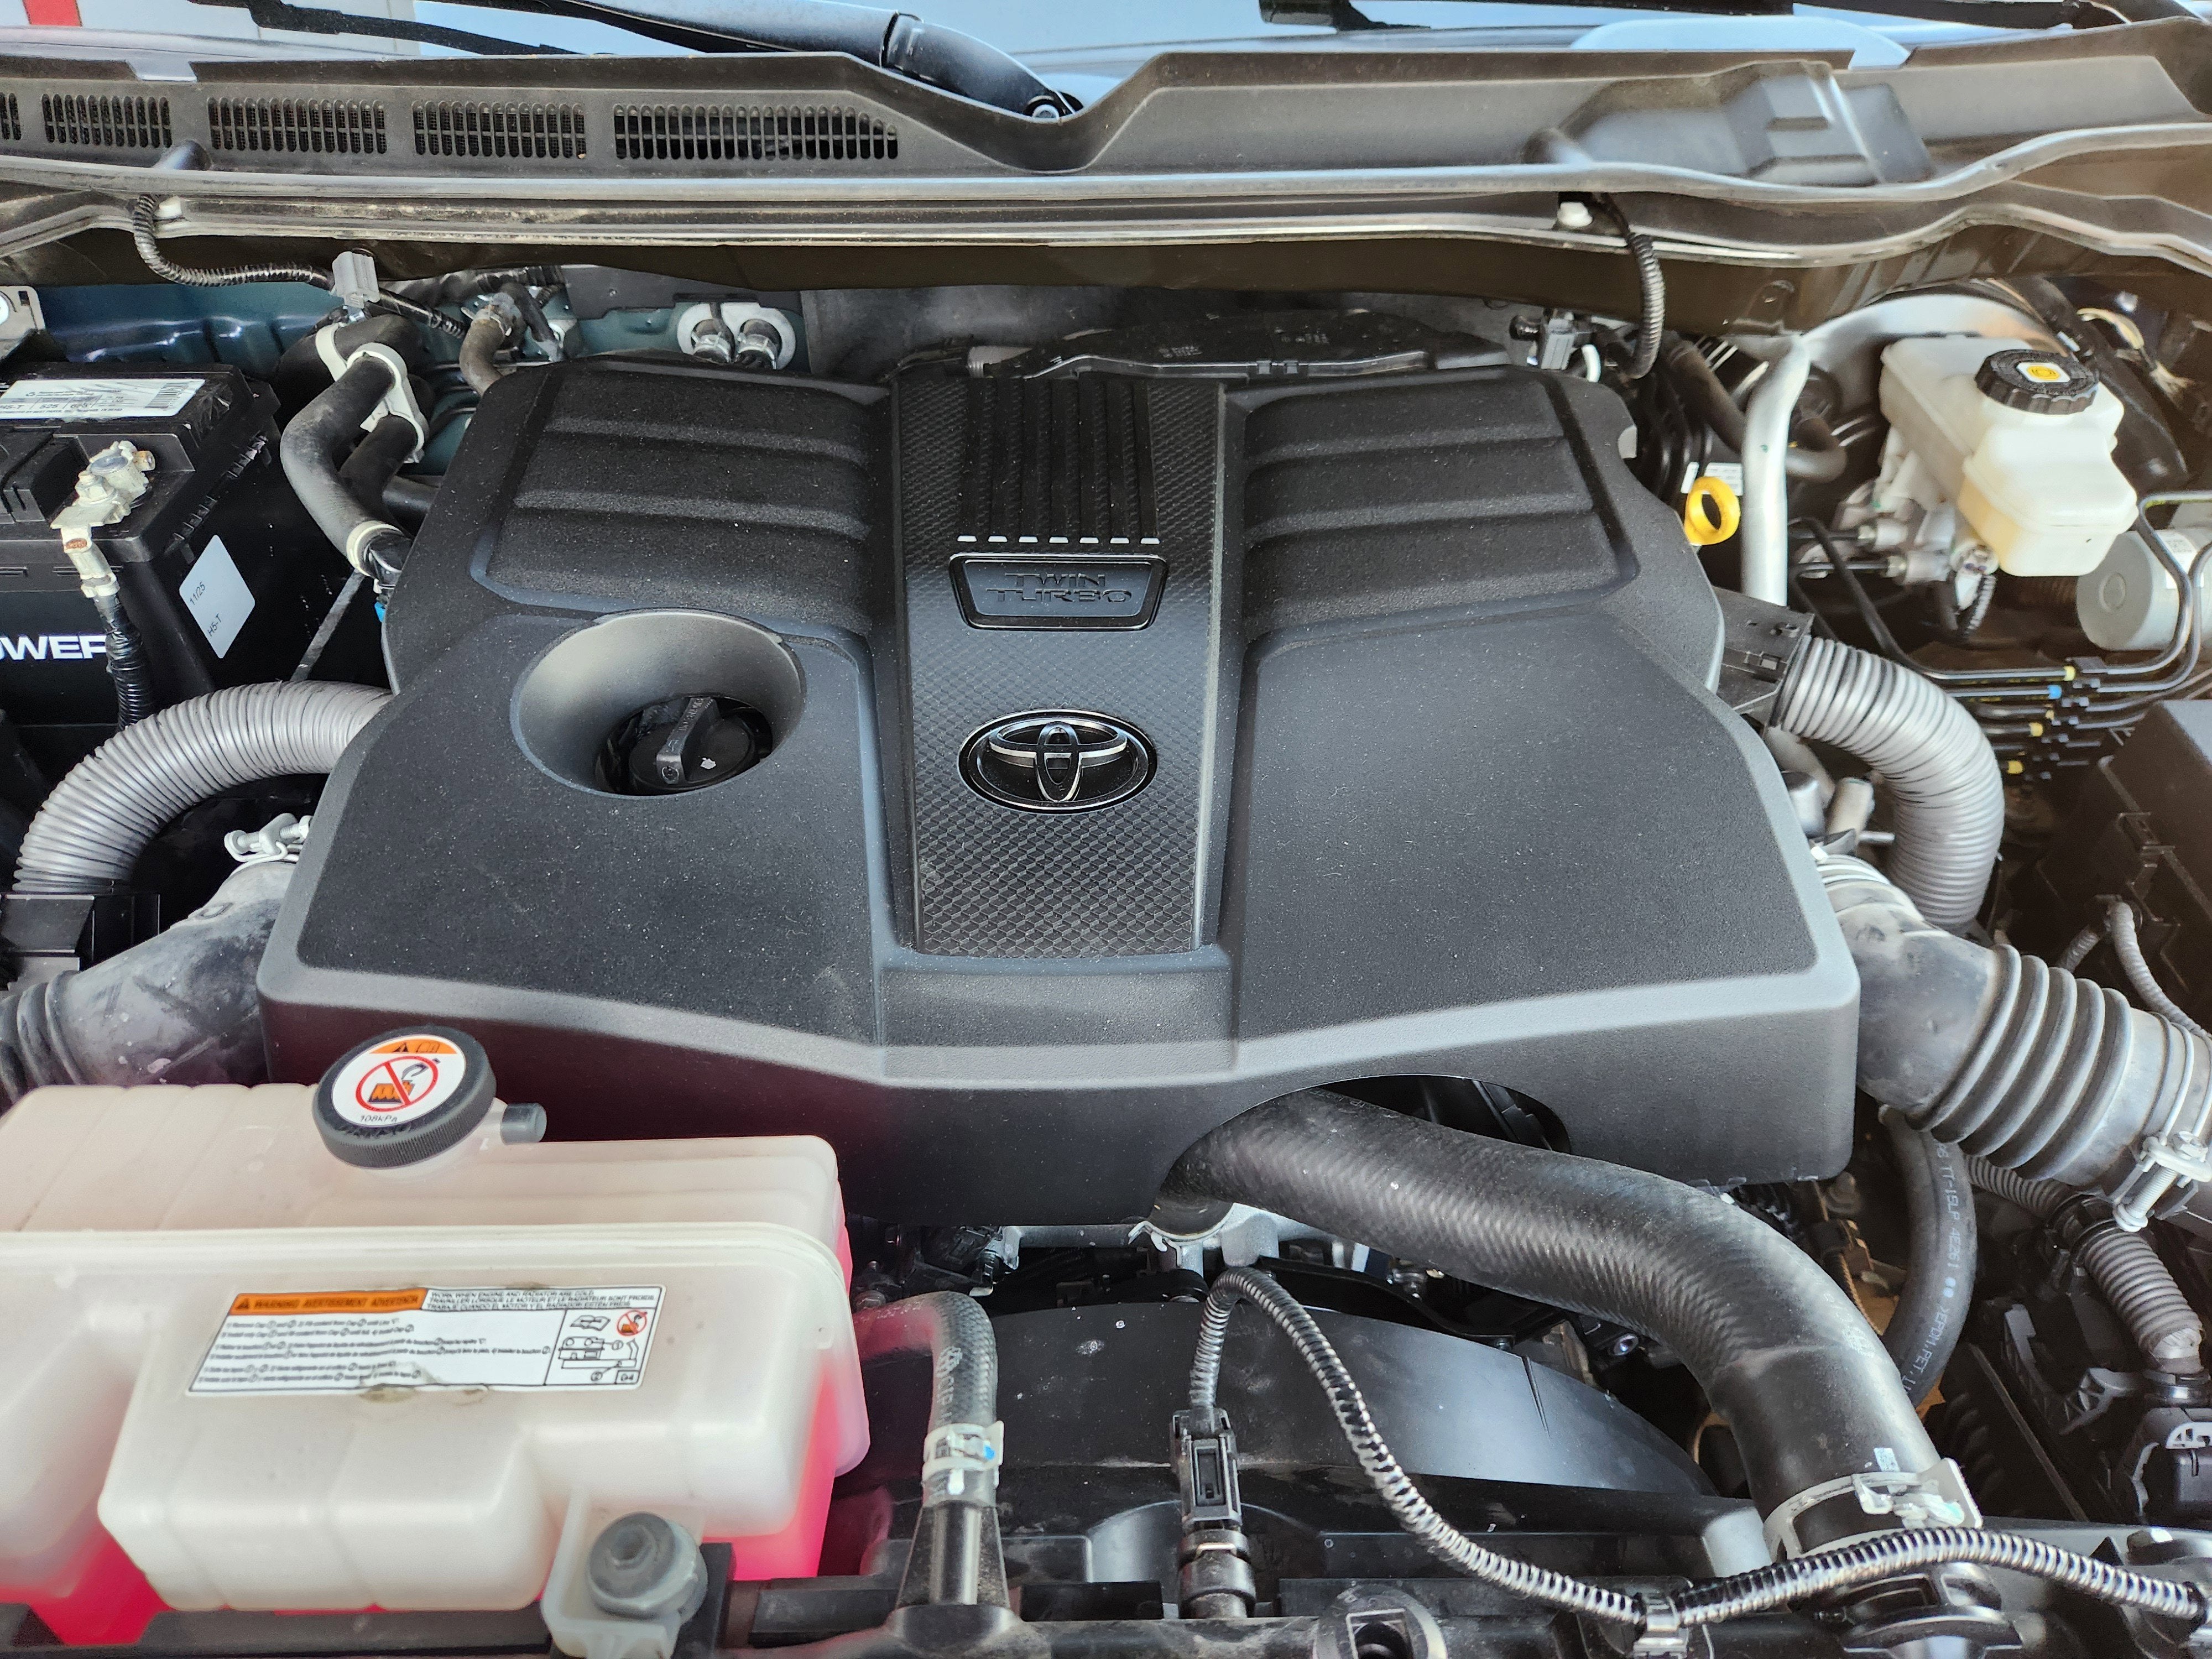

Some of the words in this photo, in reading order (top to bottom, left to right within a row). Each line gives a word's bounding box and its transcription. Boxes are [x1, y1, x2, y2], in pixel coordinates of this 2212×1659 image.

[1005, 573, 1105, 587] TWIN
[190, 581, 206, 605] 11/25
[986, 588, 1132, 602] TURBO
[207, 613, 222, 637] H5-T
